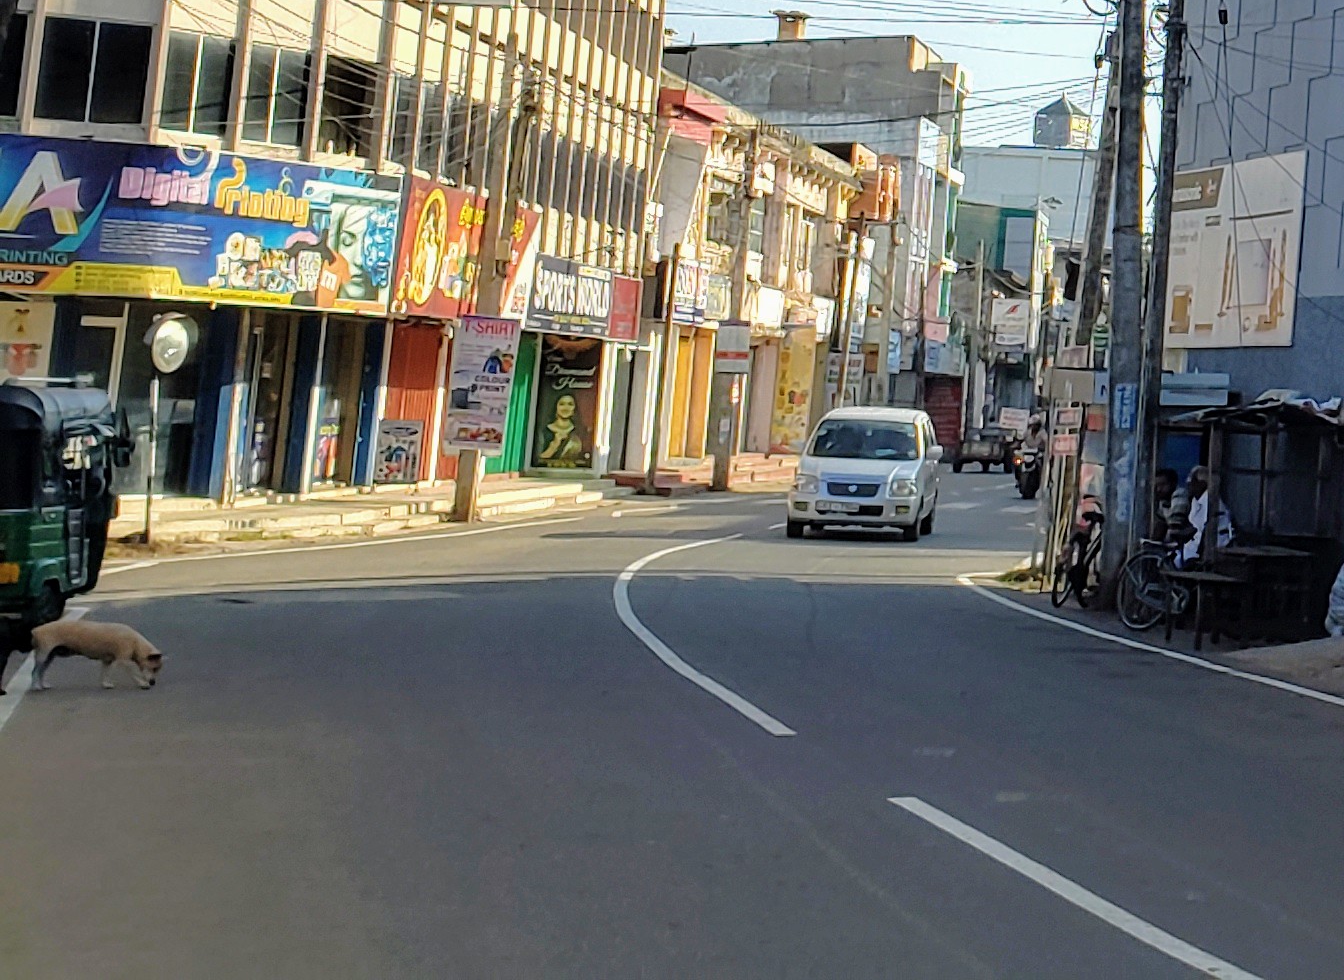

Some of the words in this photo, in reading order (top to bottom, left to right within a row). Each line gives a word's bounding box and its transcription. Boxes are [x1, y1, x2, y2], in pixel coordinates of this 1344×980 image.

[118, 166, 211, 207] Digital
[215, 158, 310, 228] Printing
[0, 248, 68, 265] RINTING
[576, 276, 610, 318] WORLD
